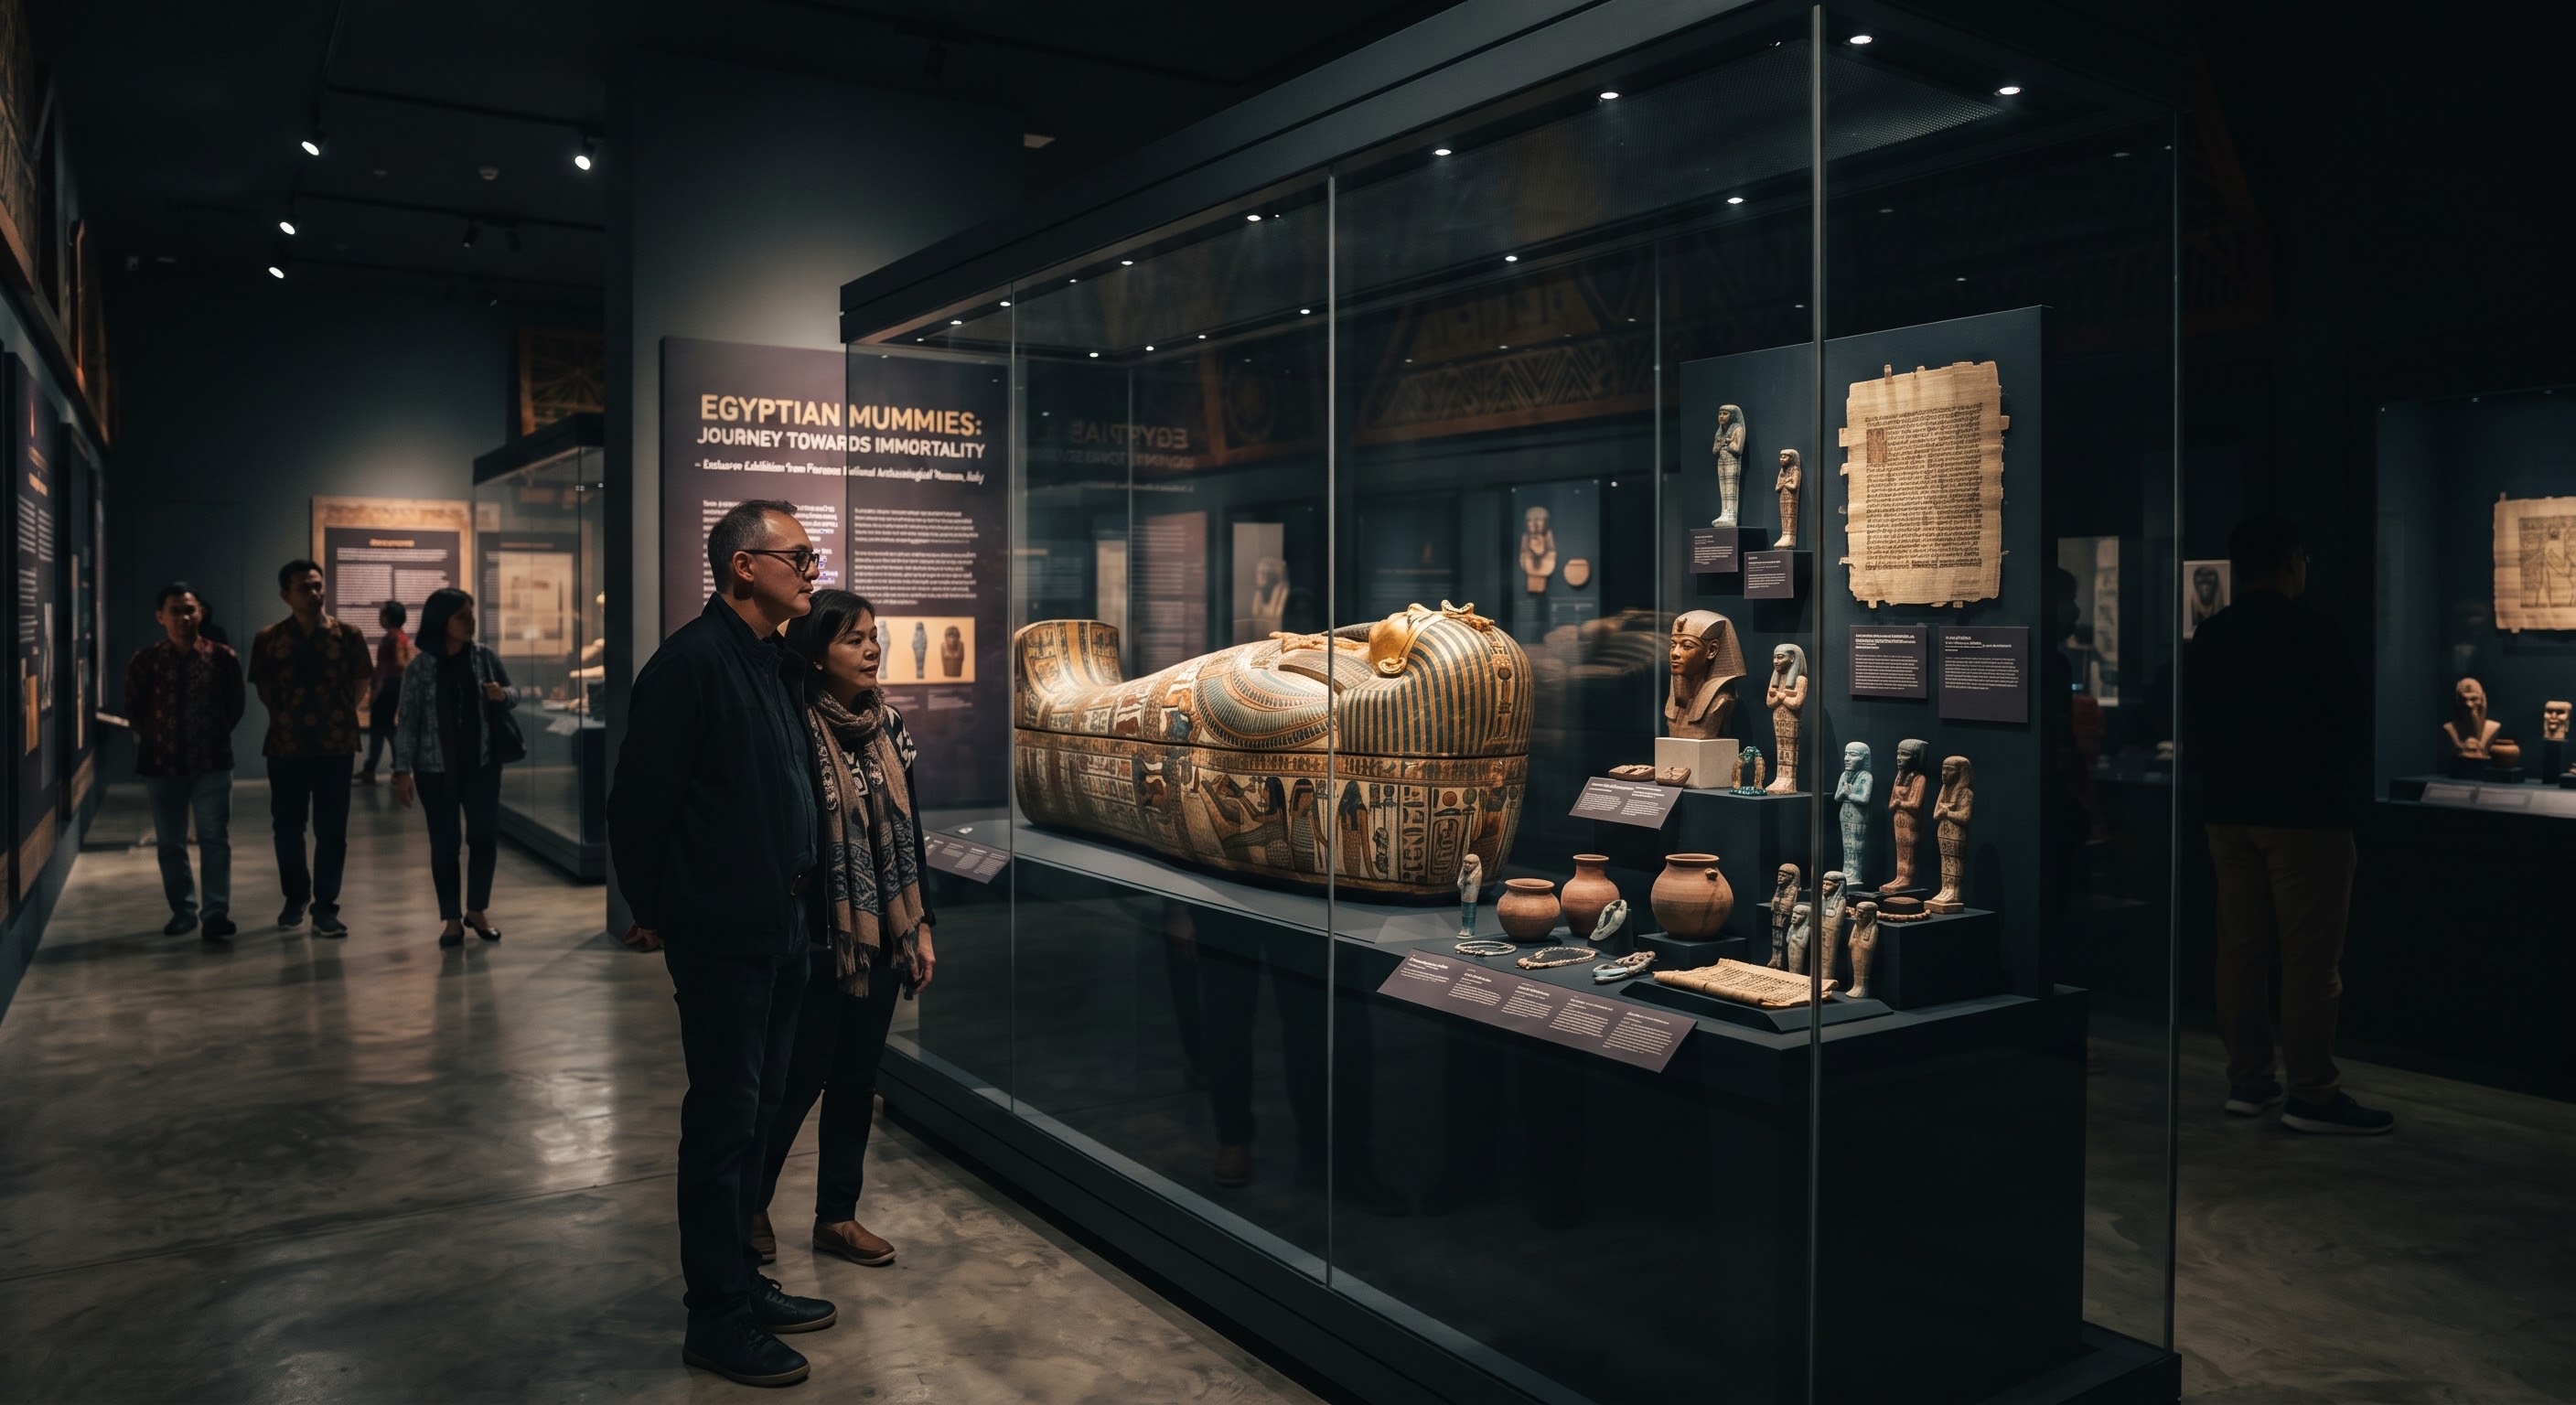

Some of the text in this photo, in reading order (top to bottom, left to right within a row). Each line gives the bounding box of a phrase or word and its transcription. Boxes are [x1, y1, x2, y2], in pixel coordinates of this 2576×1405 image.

[701, 393, 982, 436] EGYPTIAN MUMMIES:
[696, 426, 985, 458] JOURNEY TOWARDS IMMORTALITY
